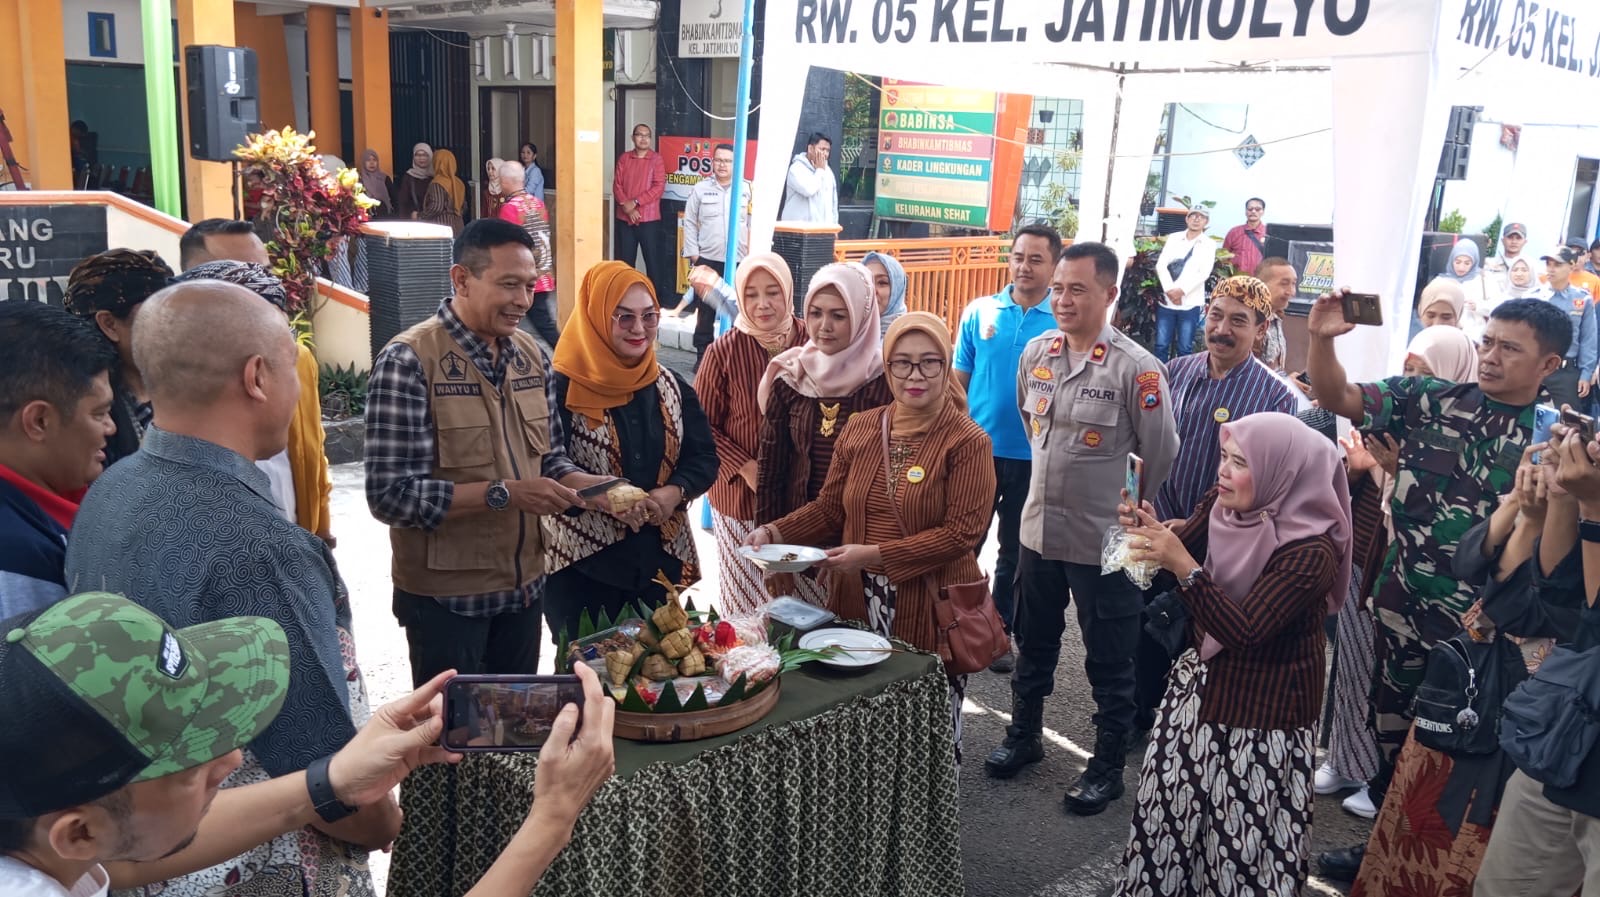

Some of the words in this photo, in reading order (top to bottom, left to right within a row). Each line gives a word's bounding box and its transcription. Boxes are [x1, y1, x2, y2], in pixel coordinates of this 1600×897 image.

[795, 0, 857, 44] RW.
[871, 0, 917, 44] 05
[930, 0, 1028, 43] KEL.
[1044, 0, 1370, 42] JATIMULYO
[681, 22, 743, 41] BHABINKAMTIBMA
[1456, 0, 1502, 51] RW.
[1508, 0, 1540, 60] 05
[1541, 8, 1583, 73] KEL.
[688, 43, 700, 55] KEL.
[702, 42, 739, 55] JATIMULYO
[900, 112, 955, 130] BABINSA
[898, 136, 973, 153] BHABINKAMTIBMAS
[677, 155, 712, 173] POS
[896, 159, 923, 173] KADER
[925, 163, 983, 177] LINGKUNGAN
[895, 203, 942, 218] KELURAHAN
[943, 207, 972, 222] SEHAT
[0, 218, 53, 241] NG
[435, 385, 470, 395] WAHYU
[472, 385, 480, 395] H
[1080, 388, 1115, 401] POLRI
